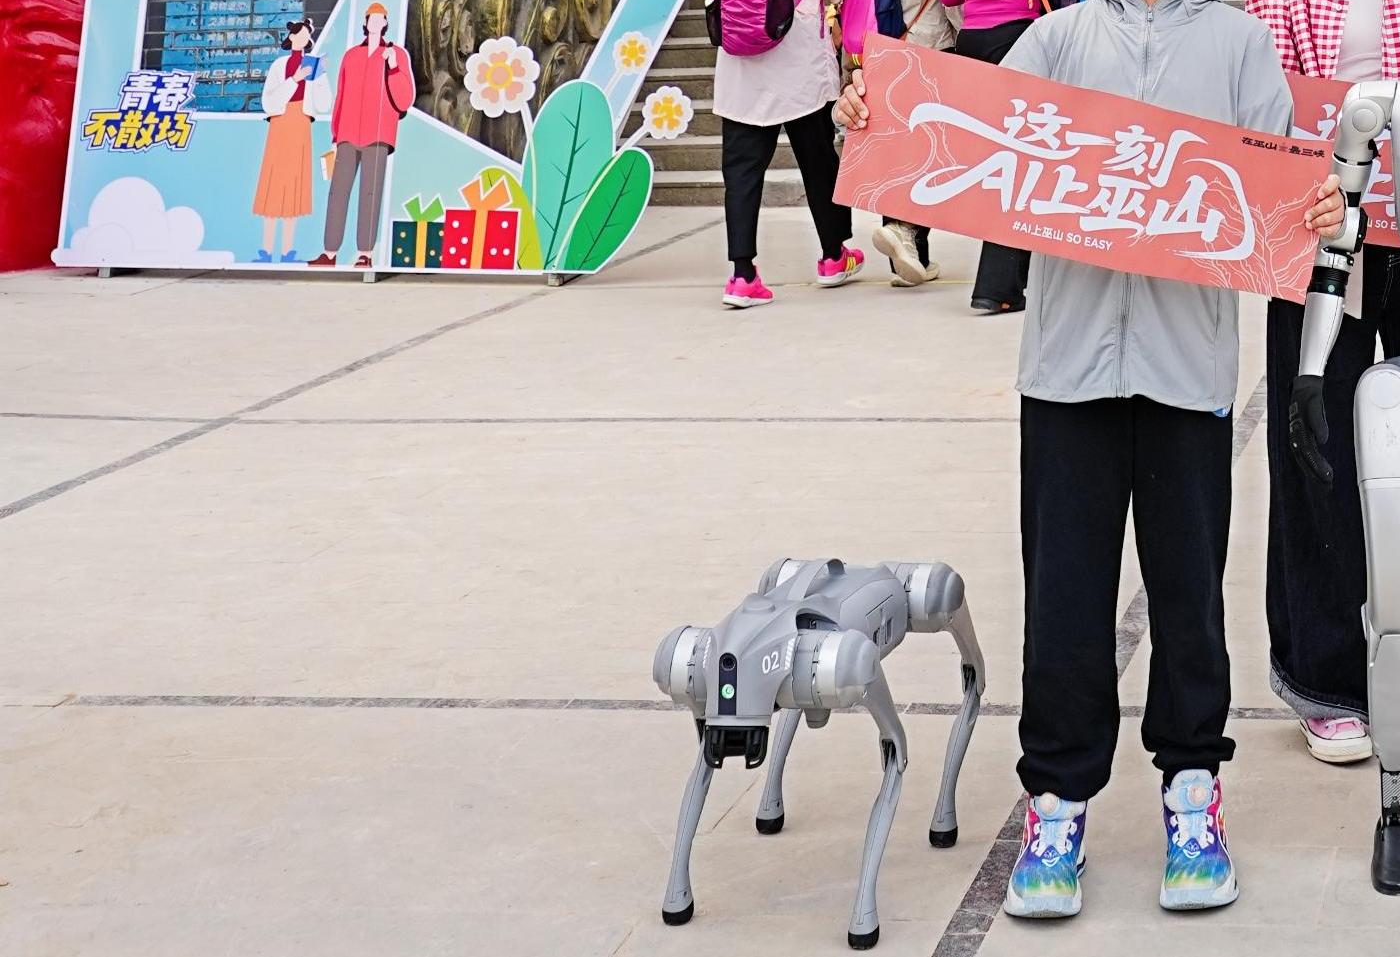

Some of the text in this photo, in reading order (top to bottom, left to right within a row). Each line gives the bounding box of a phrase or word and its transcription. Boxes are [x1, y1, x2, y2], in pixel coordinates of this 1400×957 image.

[120, 73, 190, 112] 青春
[83, 109, 193, 149] 不散场
[908, 99, 1208, 190] 这一刻
[910, 153, 1256, 261] AI上巫山
[1374, 218, 1389, 230] SO
[1012, 220, 1114, 251] #AI上巫山 SO EASY
[761, 650, 780, 674] 02
